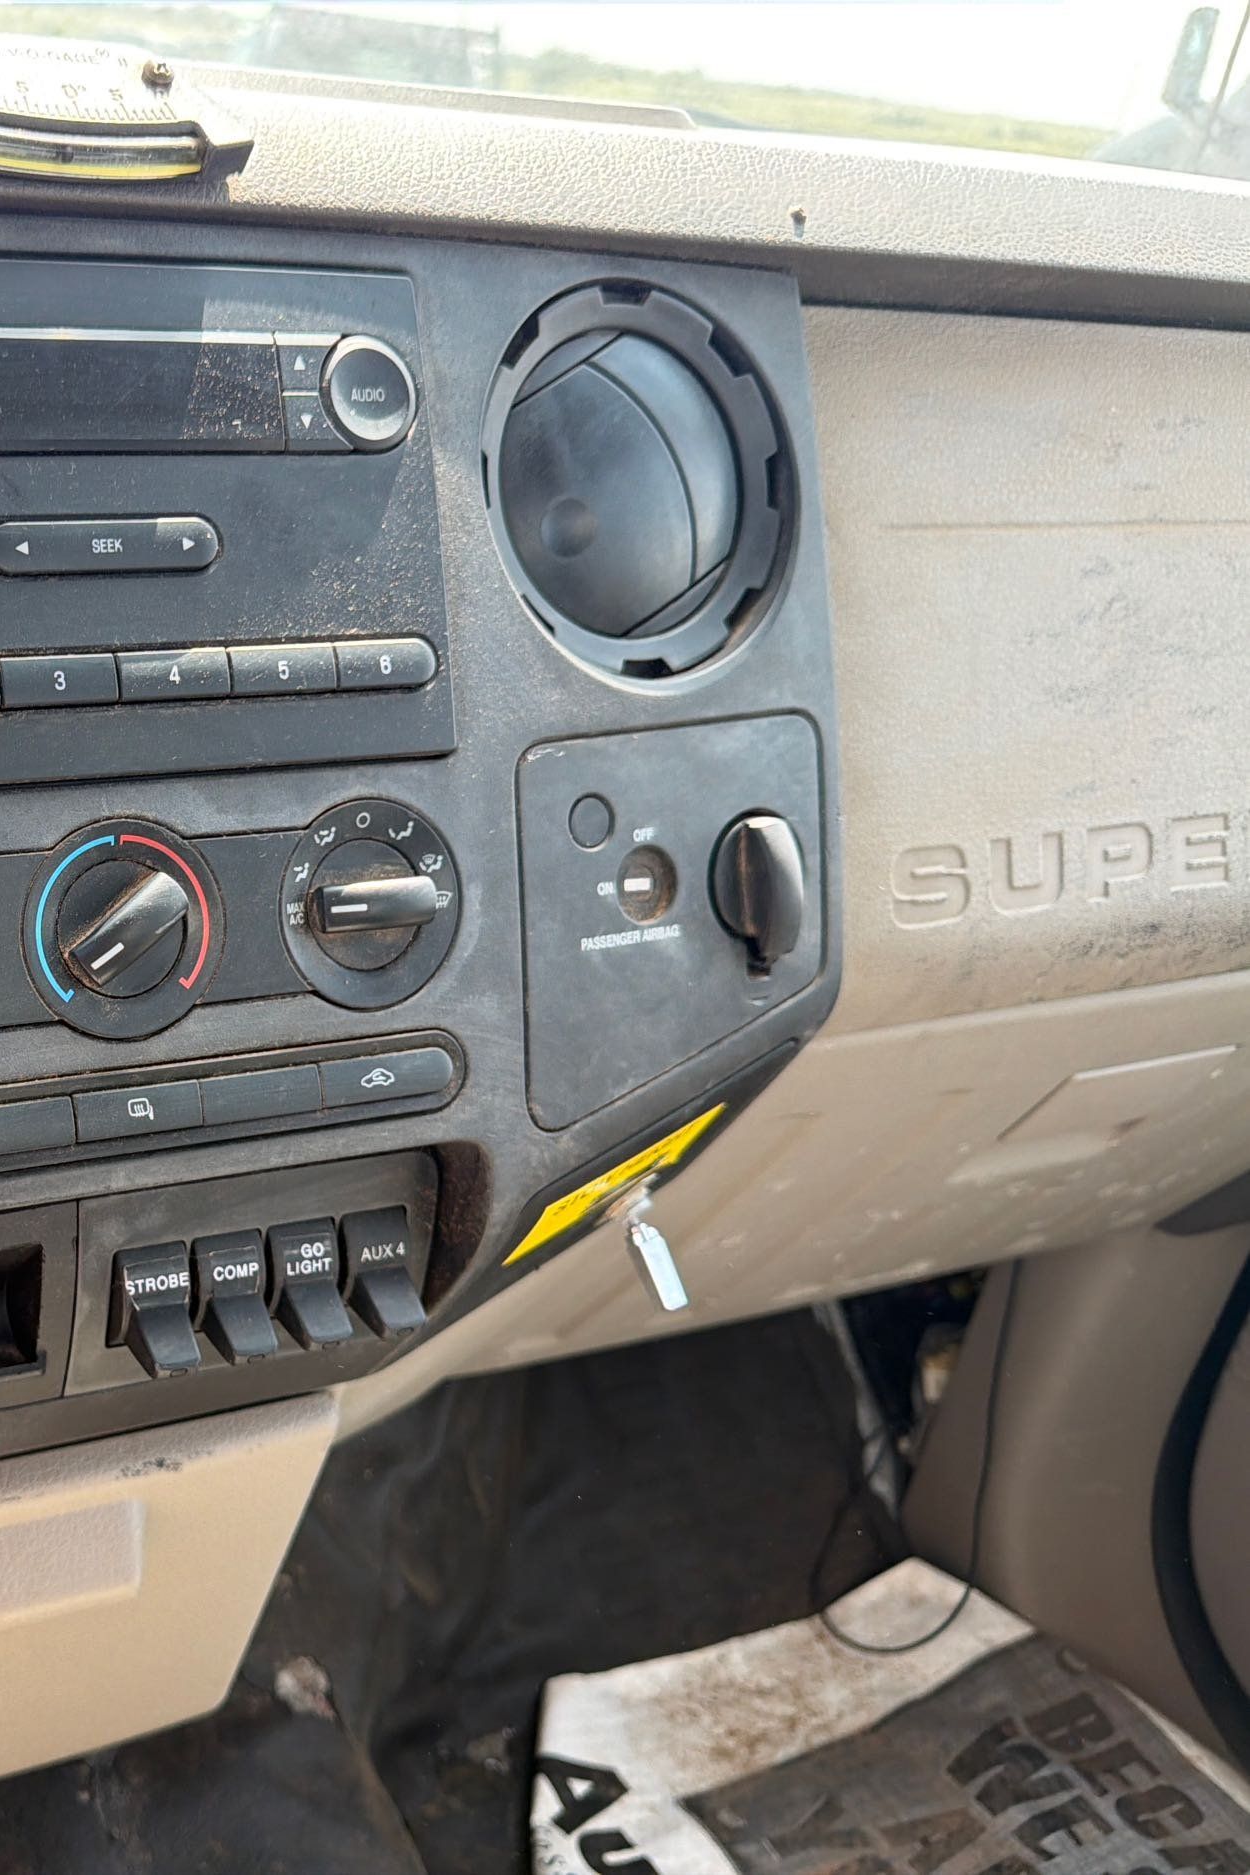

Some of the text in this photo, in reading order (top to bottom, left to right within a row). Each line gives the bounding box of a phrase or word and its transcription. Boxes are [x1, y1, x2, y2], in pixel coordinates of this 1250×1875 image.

[351, 387, 385, 402] AUDIO
[92, 537, 124, 554] SEEK
[54, 671, 66, 691] 3
[169, 664, 181, 685] 4
[278, 659, 290, 680] 5
[379, 654, 392, 675] 6
[633, 827, 655, 842] OFF
[597, 882, 615, 896] ON
[286, 902, 304, 914] MAX
[290, 912, 304, 926] A/C
[580, 923, 681, 951] PASSENGER AIRBAG
[300, 1242, 326, 1258] GO
[360, 1241, 406, 1263] AUX 4
[213, 1262, 260, 1283] COMP
[286, 1256, 334, 1277] LIGHT
[125, 1271, 190, 1296] STROBE
